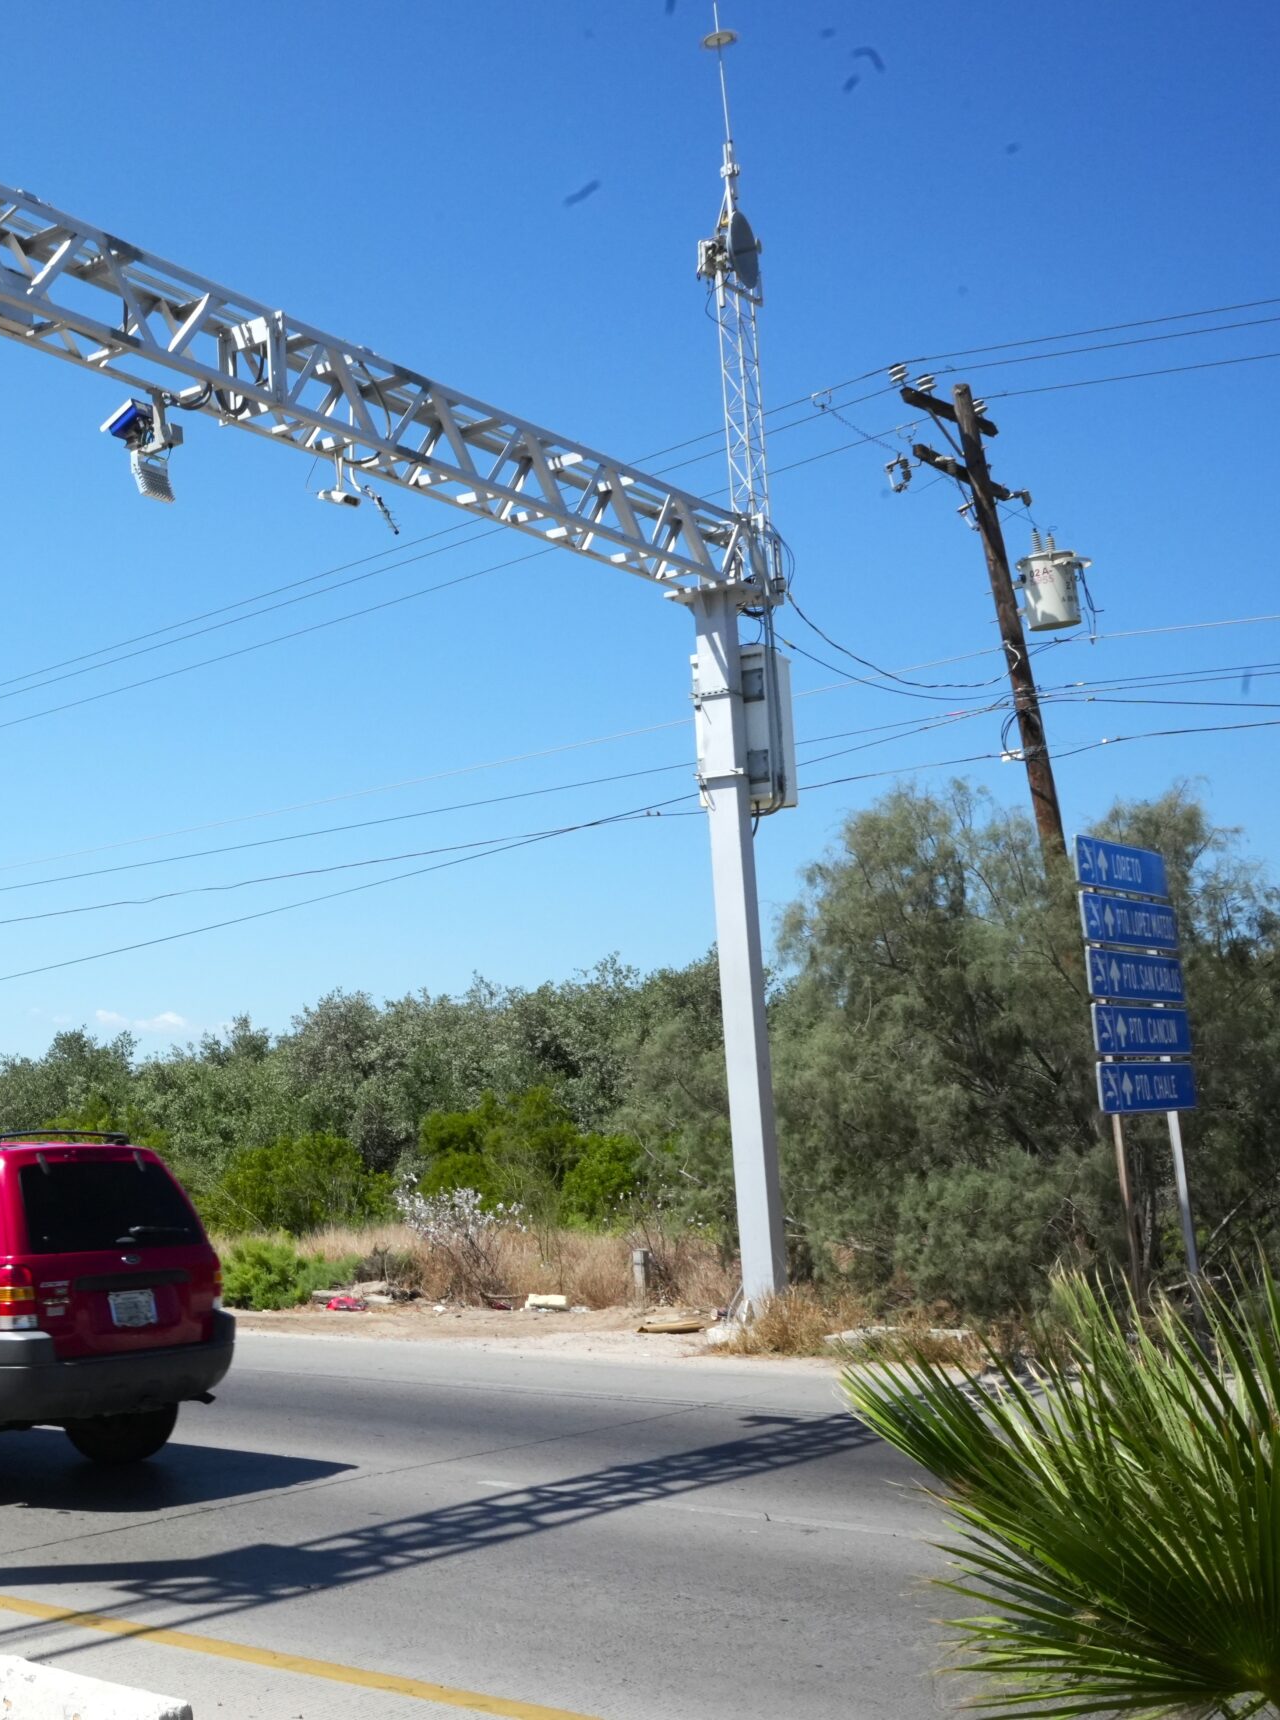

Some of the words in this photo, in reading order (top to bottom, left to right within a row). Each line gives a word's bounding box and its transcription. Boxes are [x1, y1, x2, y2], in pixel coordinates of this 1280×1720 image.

[1111, 854, 1142, 884] LORETO
[1139, 964, 1156, 991] SAN
[1154, 966, 1181, 993] CARLOS
[1153, 1075, 1178, 1099] CHALE
